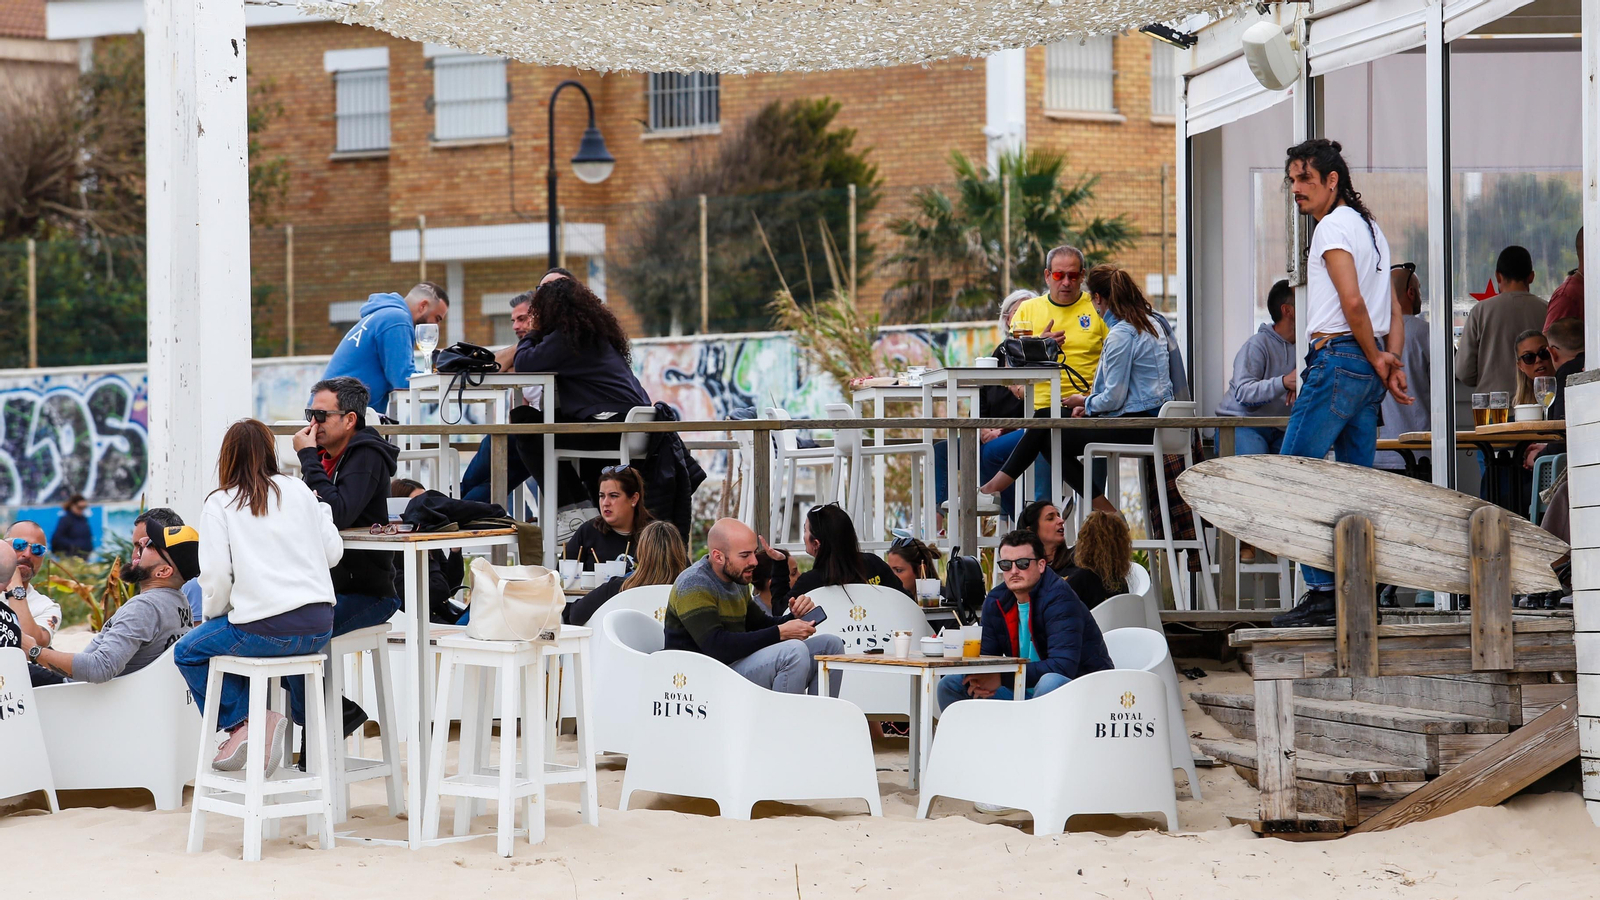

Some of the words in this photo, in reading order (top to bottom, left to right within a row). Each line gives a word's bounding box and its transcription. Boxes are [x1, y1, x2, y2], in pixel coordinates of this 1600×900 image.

[664, 691, 694, 702] ROYAL
[653, 701, 707, 720] BLISS
[1110, 712, 1143, 721] ROYAL
[1095, 721, 1155, 738] BLISS
